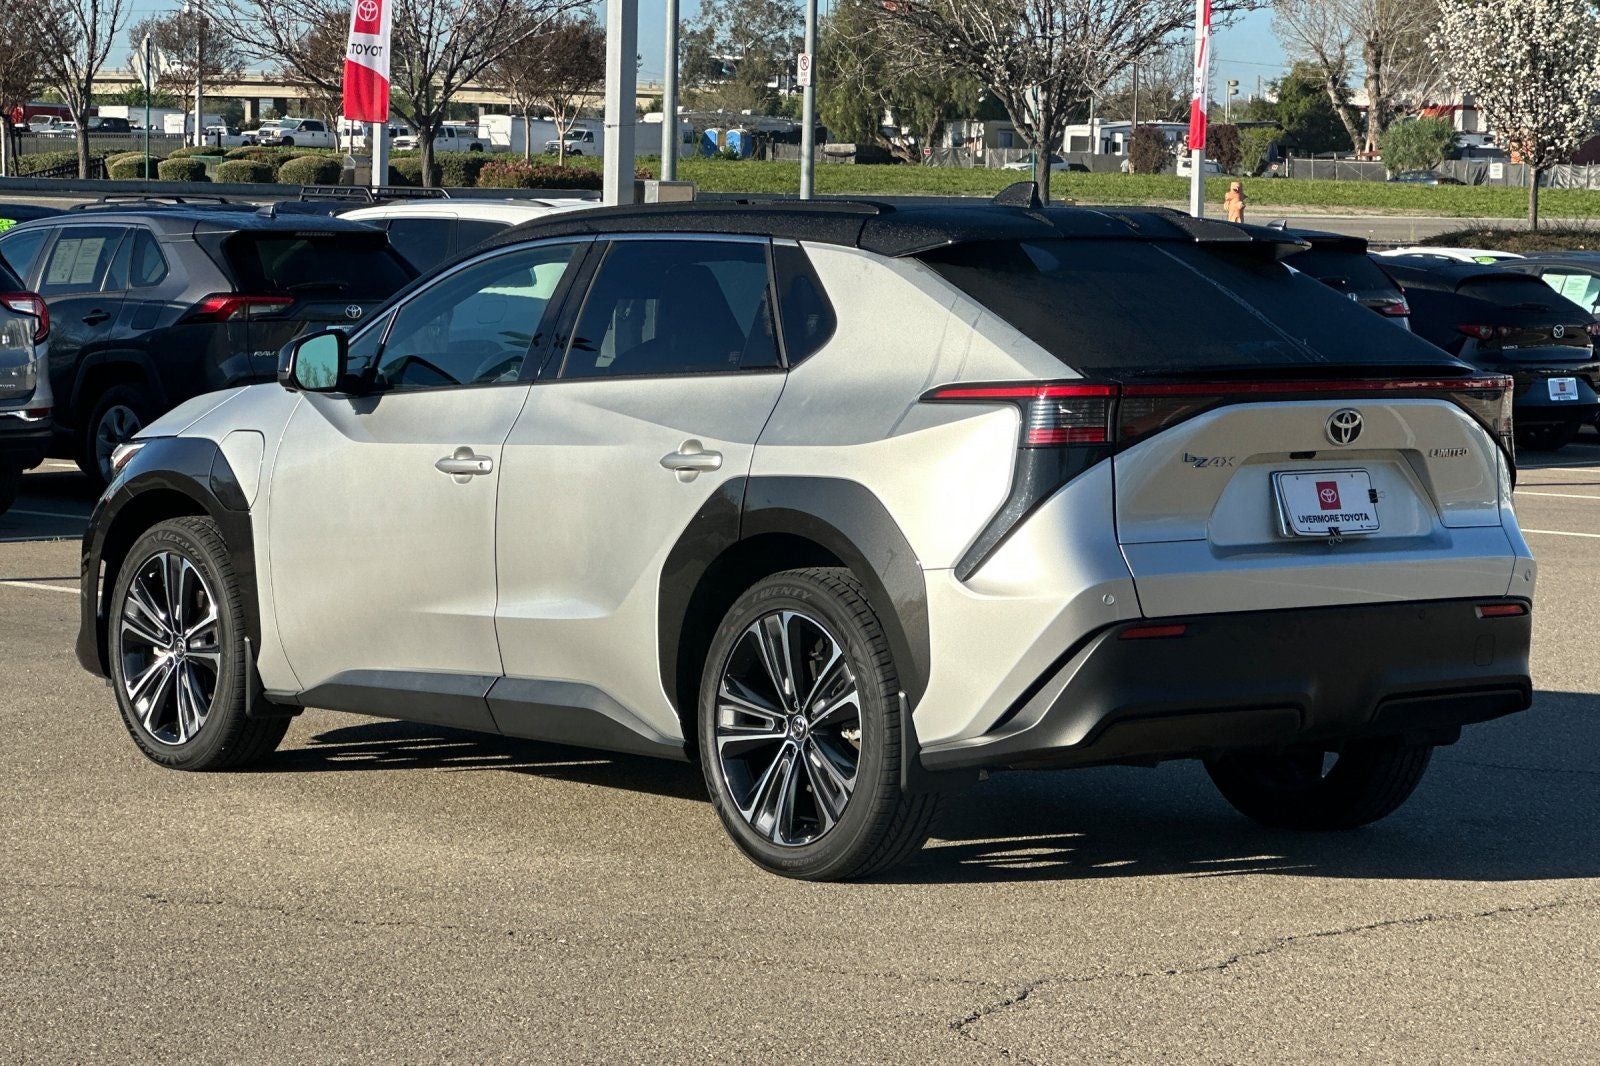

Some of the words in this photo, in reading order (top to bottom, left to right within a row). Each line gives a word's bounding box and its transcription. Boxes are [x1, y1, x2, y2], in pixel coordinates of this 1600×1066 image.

[351, 43, 382, 57] TOYOT
[1429, 447, 1470, 457] LIMITED
[1298, 513, 1340, 523] LIVERMORE
[1341, 512, 1370, 522] TOYOTA
